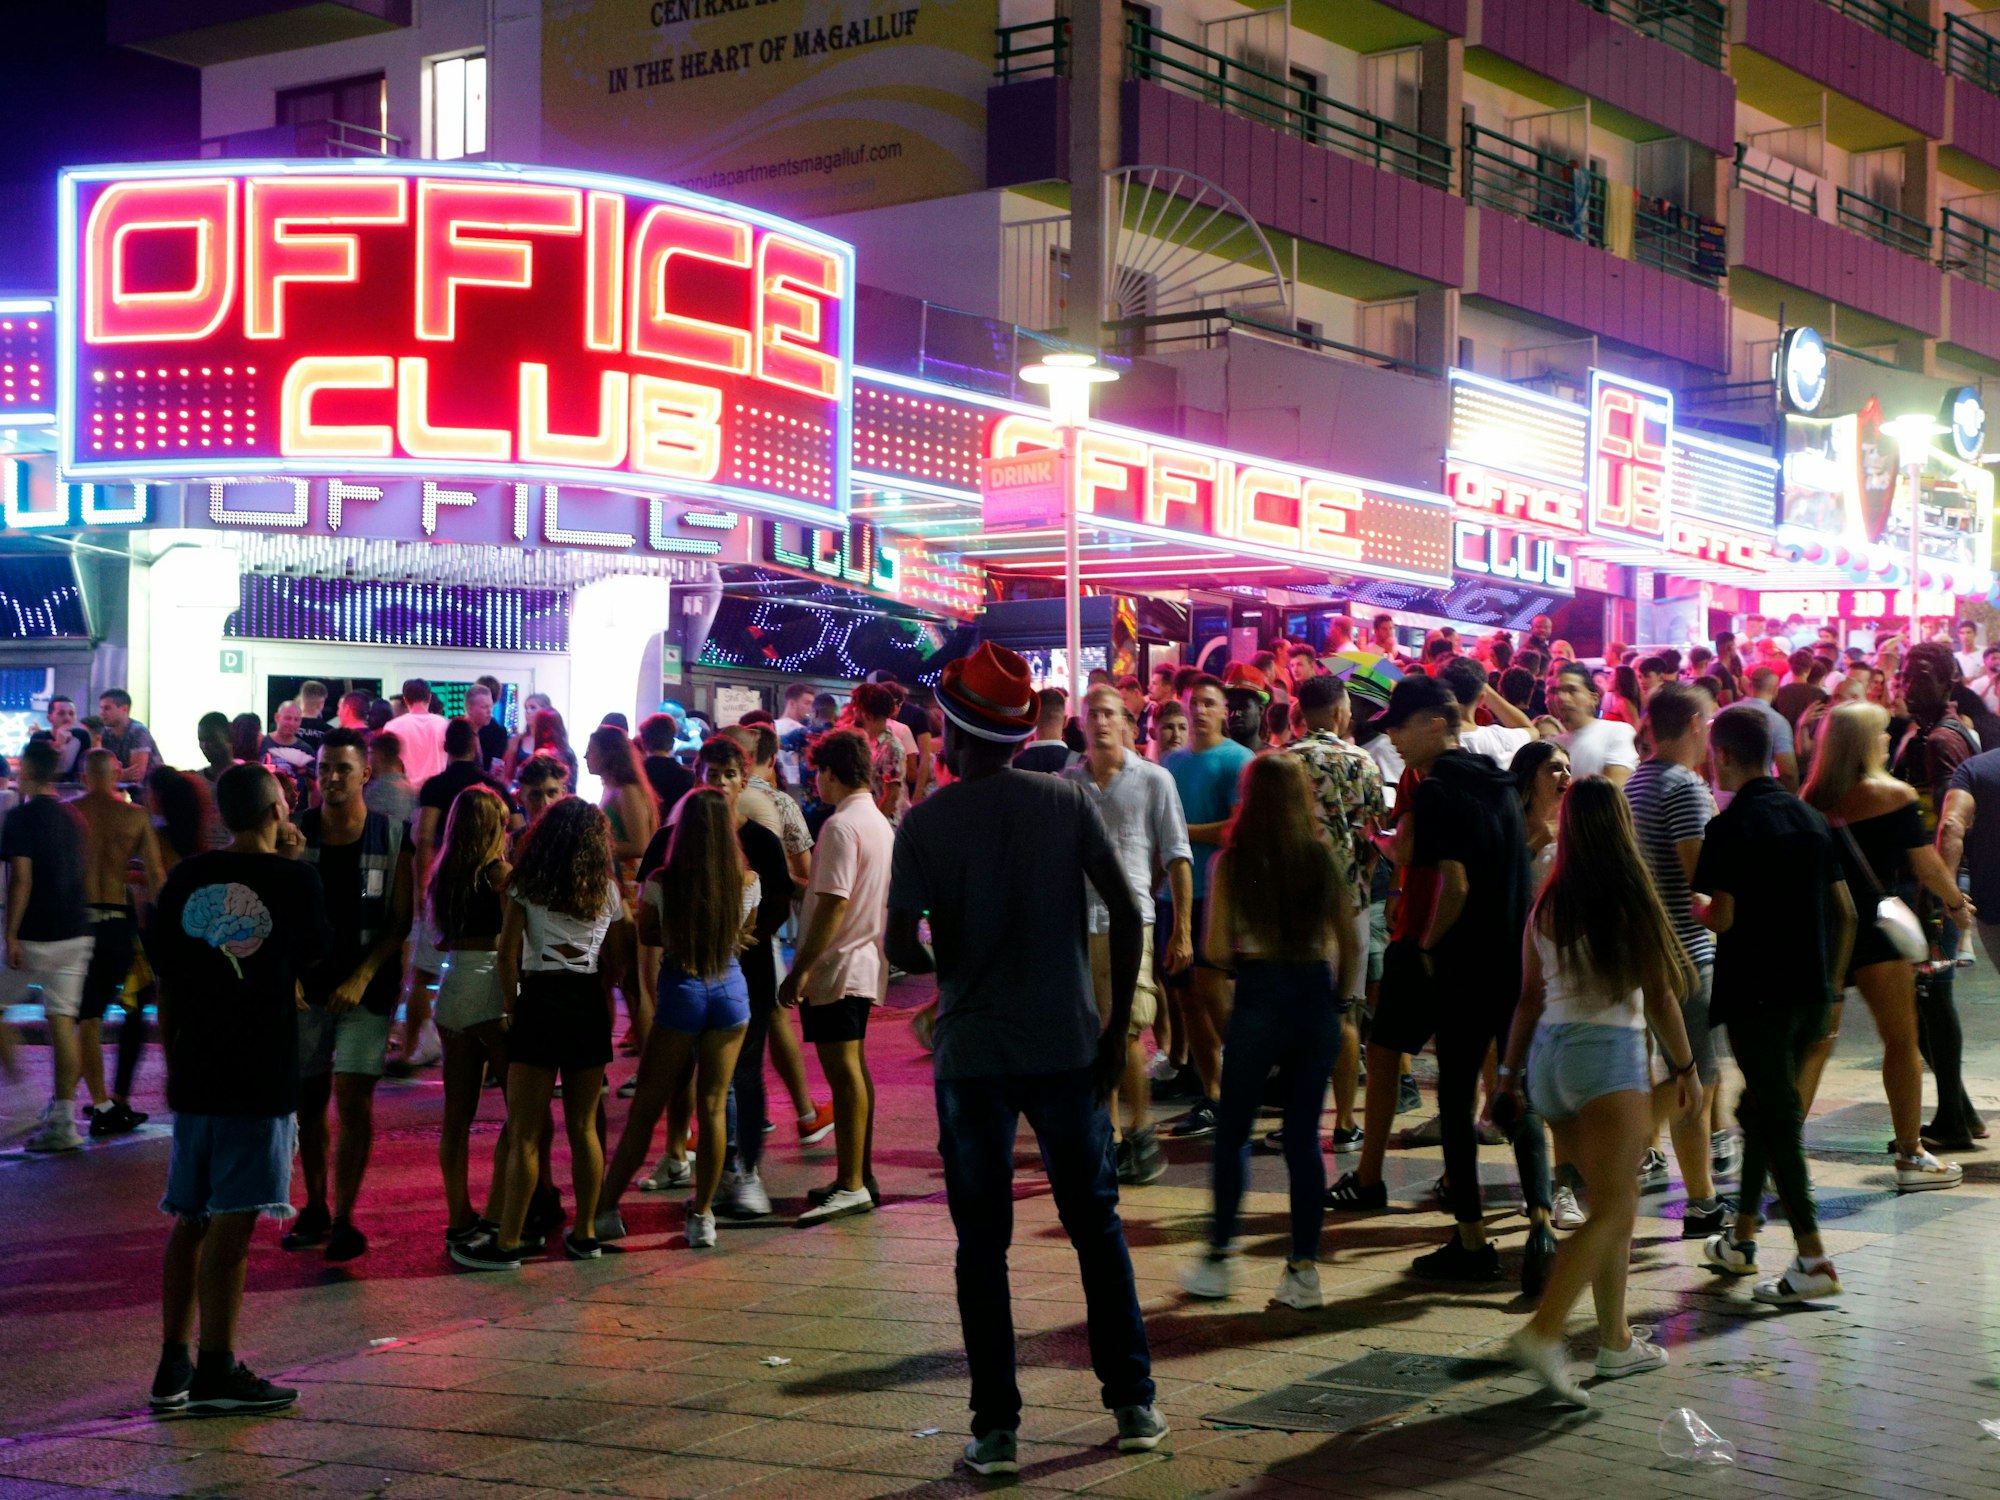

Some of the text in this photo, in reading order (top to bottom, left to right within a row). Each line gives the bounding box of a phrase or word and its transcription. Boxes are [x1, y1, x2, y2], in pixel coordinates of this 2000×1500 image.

[608, 9, 919, 94] IN THE HEART OF MAGALLUF
[83, 176, 844, 400] OFFICE
[280, 355, 723, 482] CLUB
[991, 462, 1052, 488] DRINK
[1457, 468, 1583, 530] OFFICE
[1671, 521, 1772, 571] OFFICE
[224, 652, 238, 667] D
